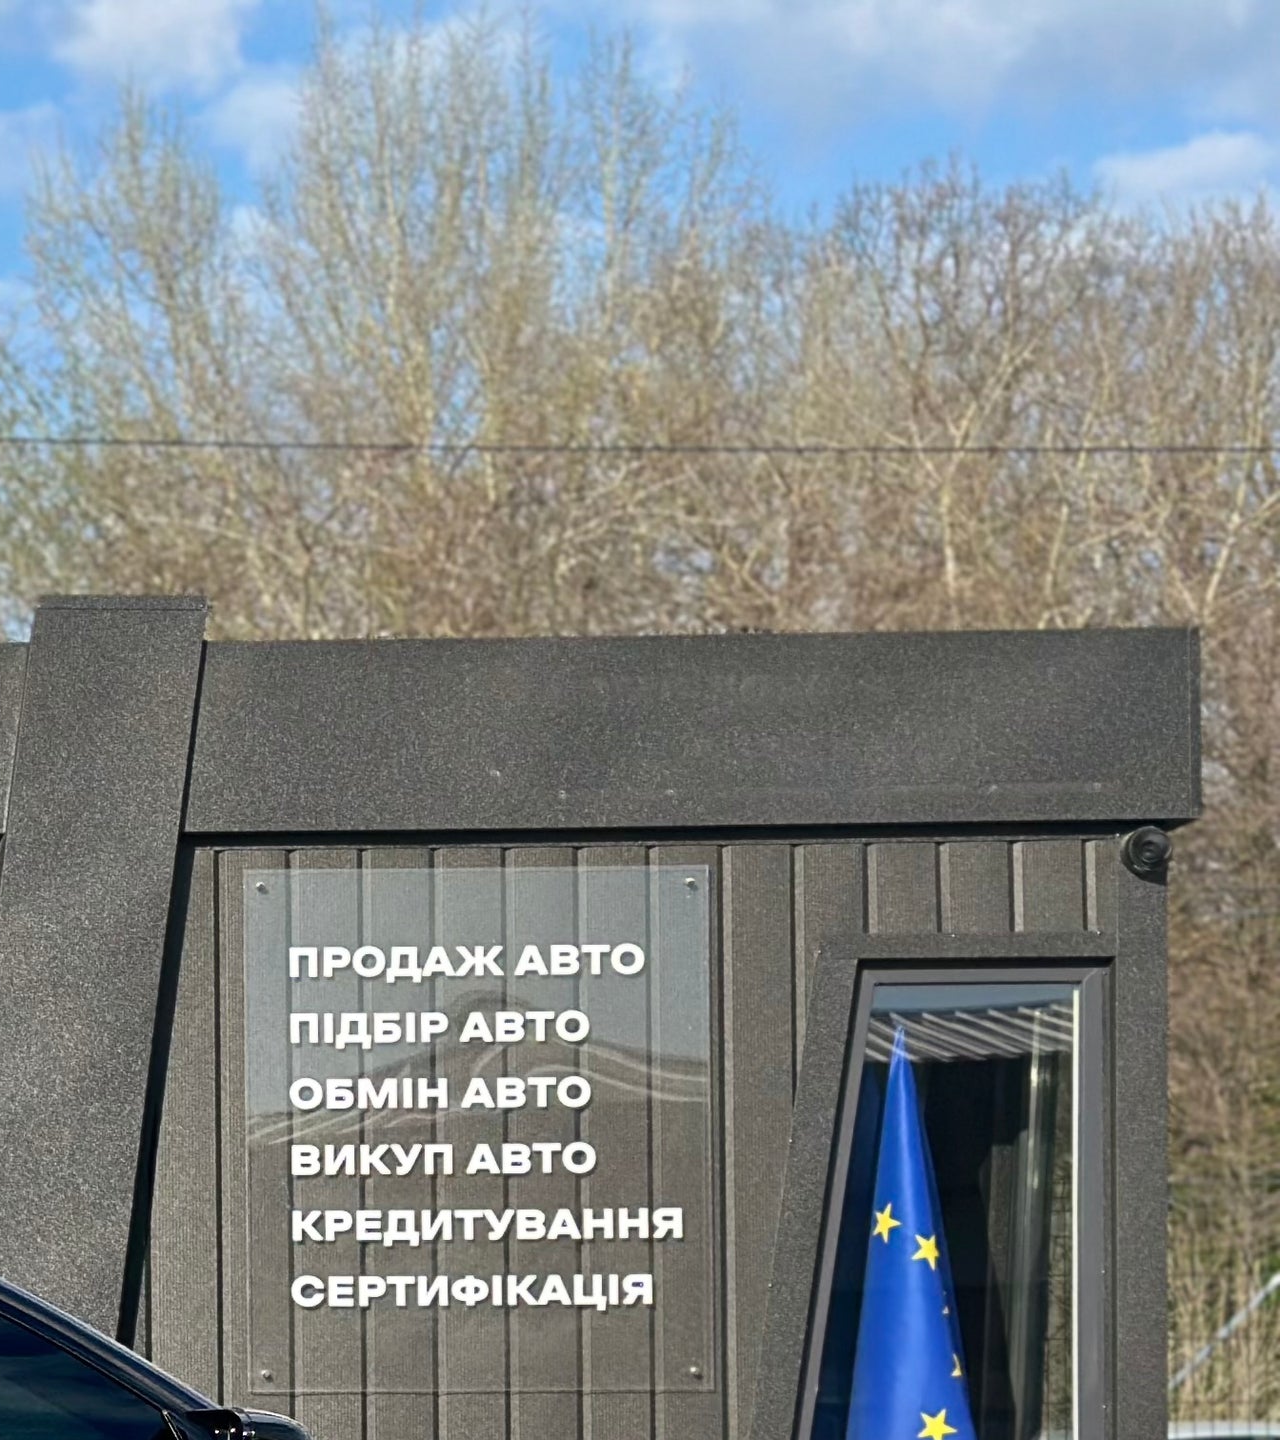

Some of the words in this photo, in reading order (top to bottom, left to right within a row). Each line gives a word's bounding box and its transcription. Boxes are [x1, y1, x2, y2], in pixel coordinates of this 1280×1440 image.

[288, 945, 505, 984] ПРОДАЖ
[514, 942, 646, 976] АВТО
[289, 1011, 449, 1050] ПІДБІР
[459, 1009, 590, 1043] АВТО
[289, 1077, 448, 1110] ОБМІН
[461, 1075, 592, 1109] АВТО
[291, 1143, 453, 1176] ВИКУП
[466, 1141, 597, 1174] АВТО
[291, 1207, 683, 1247] КРЕДИТУВАННЯ
[291, 1273, 653, 1311] СЕРТИФІКАЦІЯ
